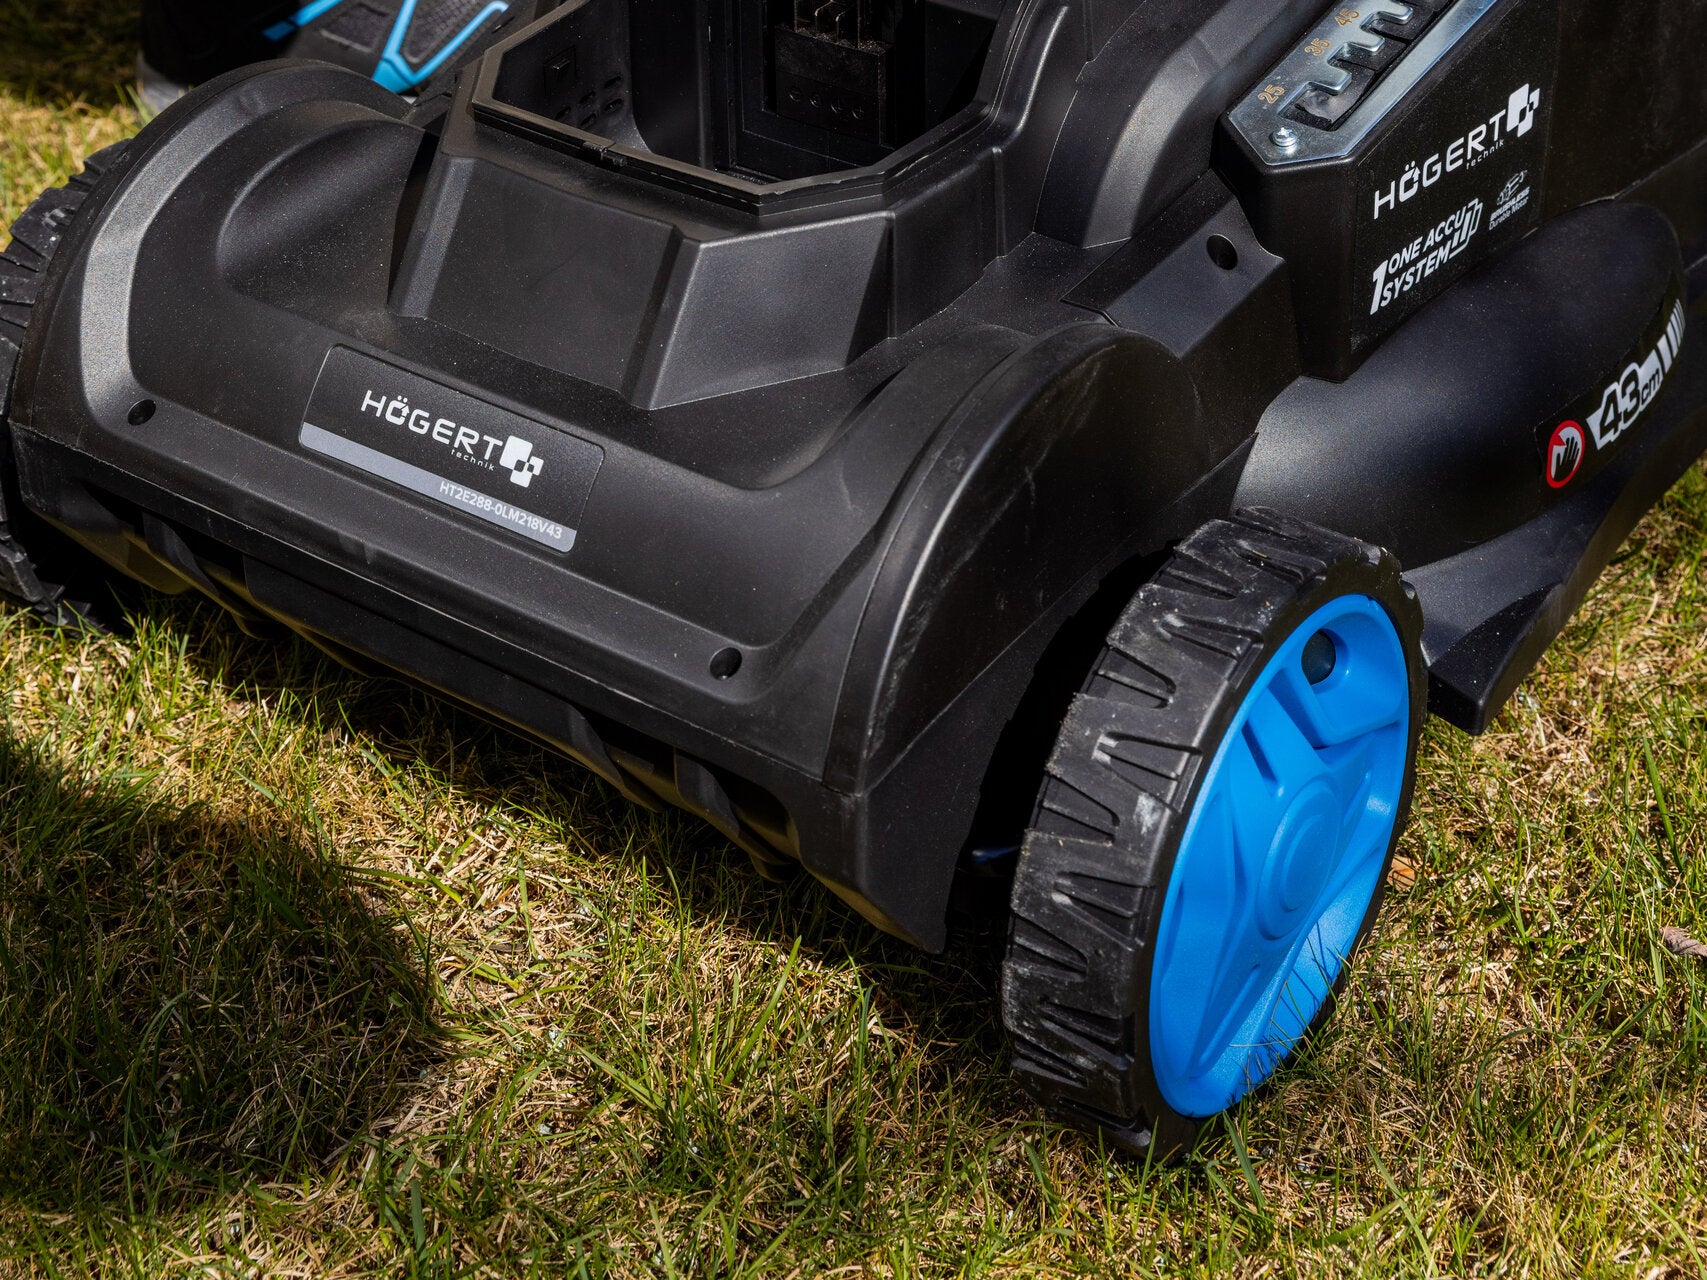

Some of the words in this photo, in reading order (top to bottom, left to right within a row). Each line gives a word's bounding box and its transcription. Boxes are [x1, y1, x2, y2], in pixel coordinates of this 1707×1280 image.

[1334, 8, 1360, 27] 45
[1304, 38, 1331, 56] 35
[1258, 84, 1285, 104] 25
[1373, 108, 1506, 220] HÖGERT
[1466, 138, 1505, 170] technik
[1369, 259, 1389, 316] 1
[1388, 236, 1423, 274] ONE
[1422, 205, 1468, 252] ACCU
[1380, 240, 1451, 307] SYSTEM
[361, 390, 503, 461] HÖGERT
[451, 449, 495, 472] technik
